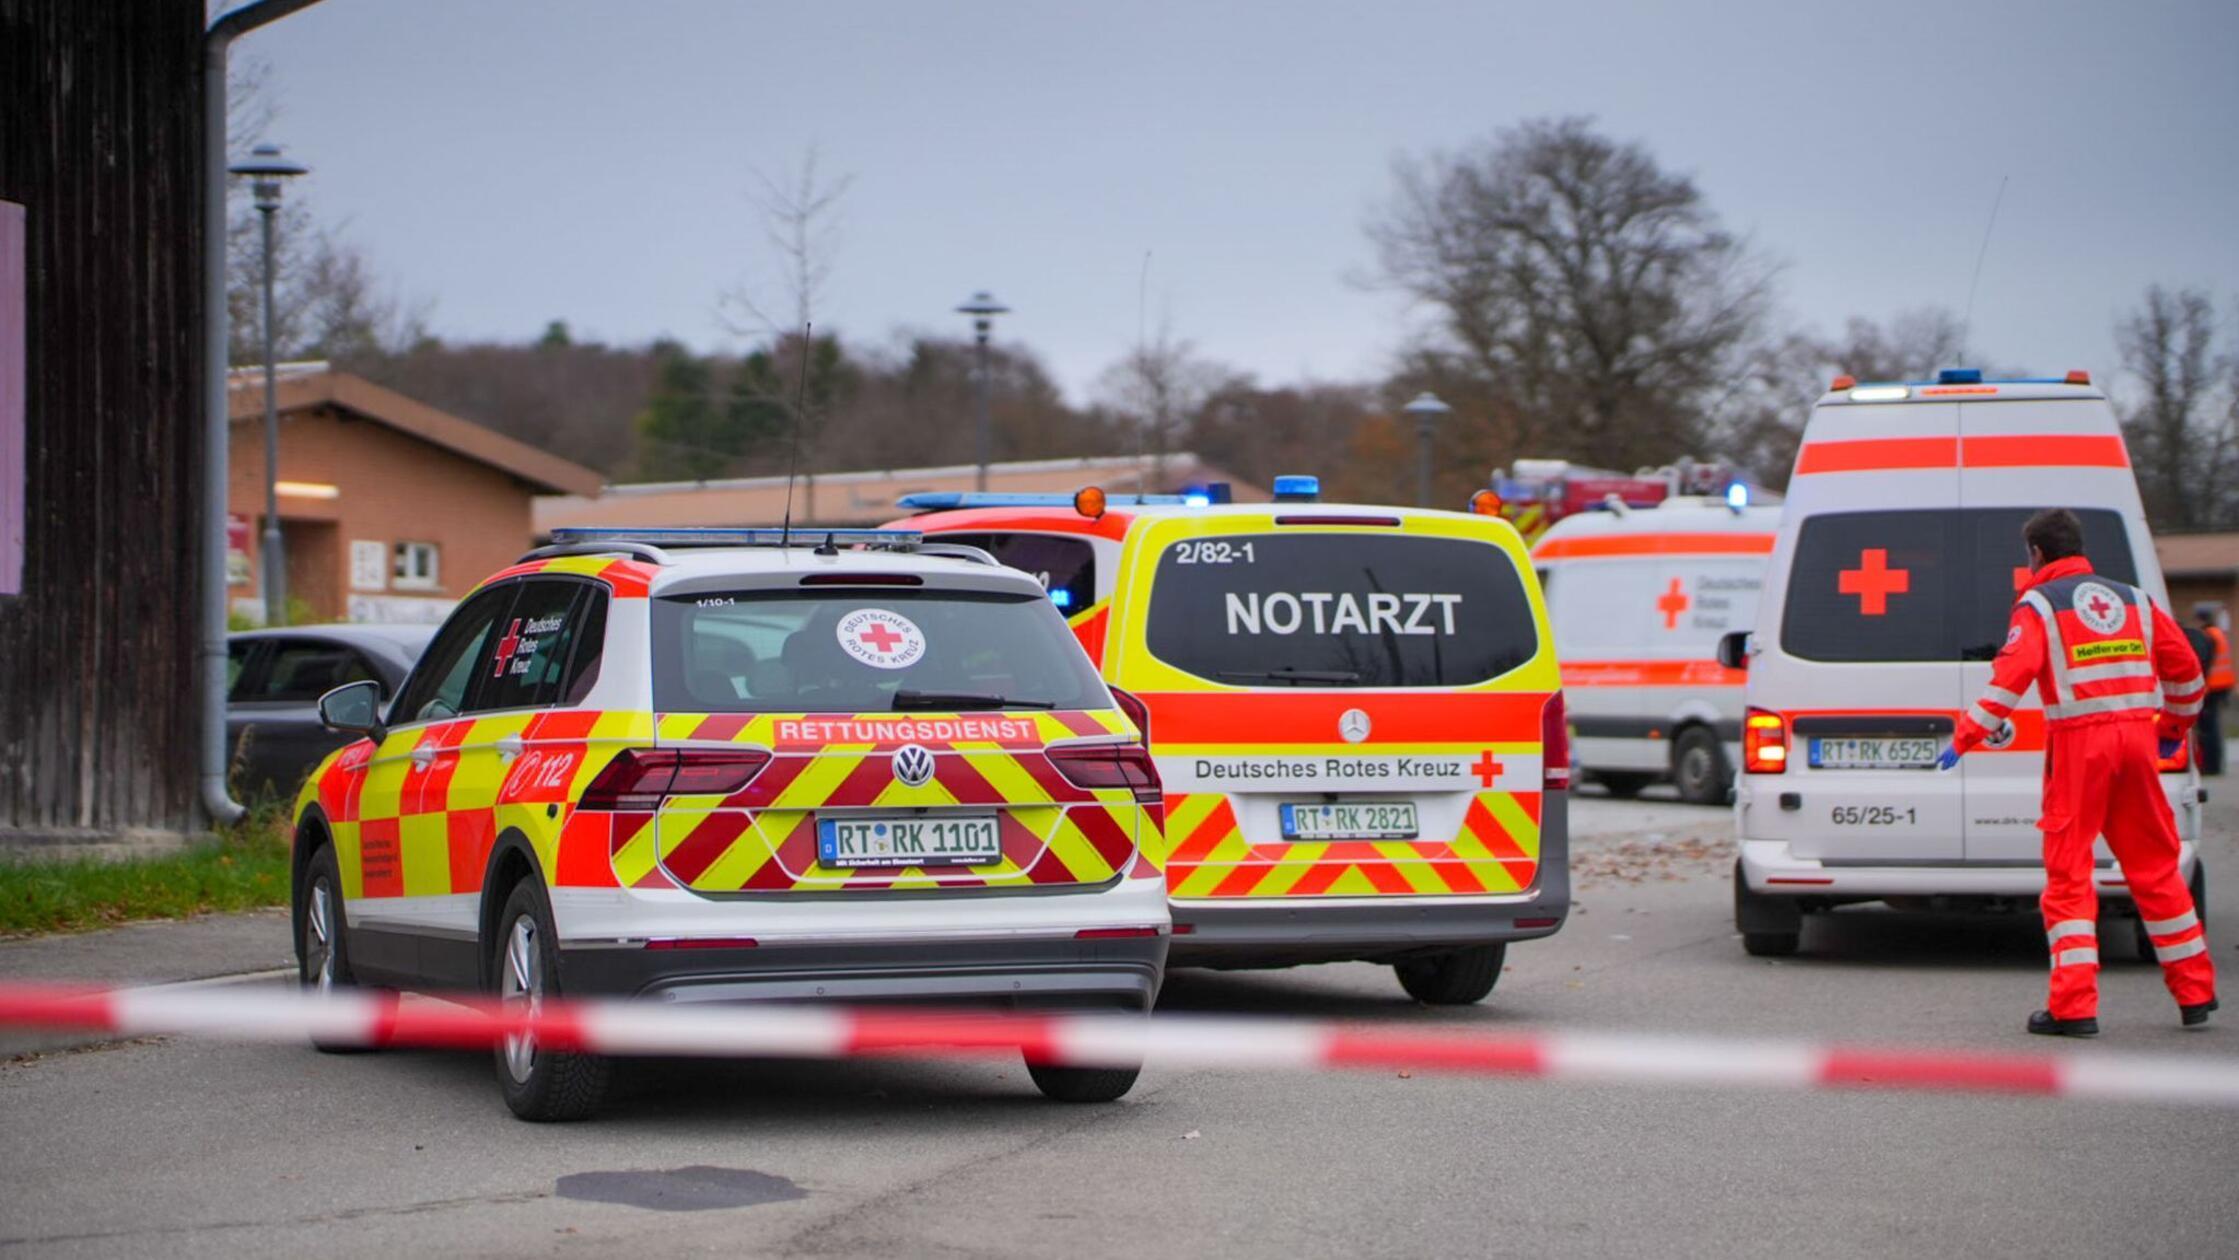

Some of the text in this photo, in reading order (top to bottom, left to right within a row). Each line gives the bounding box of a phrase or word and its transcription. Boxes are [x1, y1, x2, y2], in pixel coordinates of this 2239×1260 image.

[1176, 543, 1255, 563] 2/82-1
[696, 597, 735, 608] 1/10-1
[844, 613, 912, 634] DEUTSCHES
[1225, 592, 1463, 635] NOTARZT
[524, 618, 562, 634] Deutsches
[517, 637, 539, 654] Rotes
[847, 639, 919, 664] ROTES KREUZ
[2077, 645, 2112, 657] Helfer
[510, 659, 532, 674] Kreuz
[780, 720, 1031, 740] RETTUNGSDIENST
[1823, 741, 1934, 761] RT RK 6525
[533, 752, 574, 788] 112
[1195, 758, 1461, 779] Deutsches Rotes Kreuz
[1295, 807, 1414, 830] RT RK 2821
[1832, 806, 1917, 825] 65/25-1
[838, 822, 996, 854] RT RK 1101
